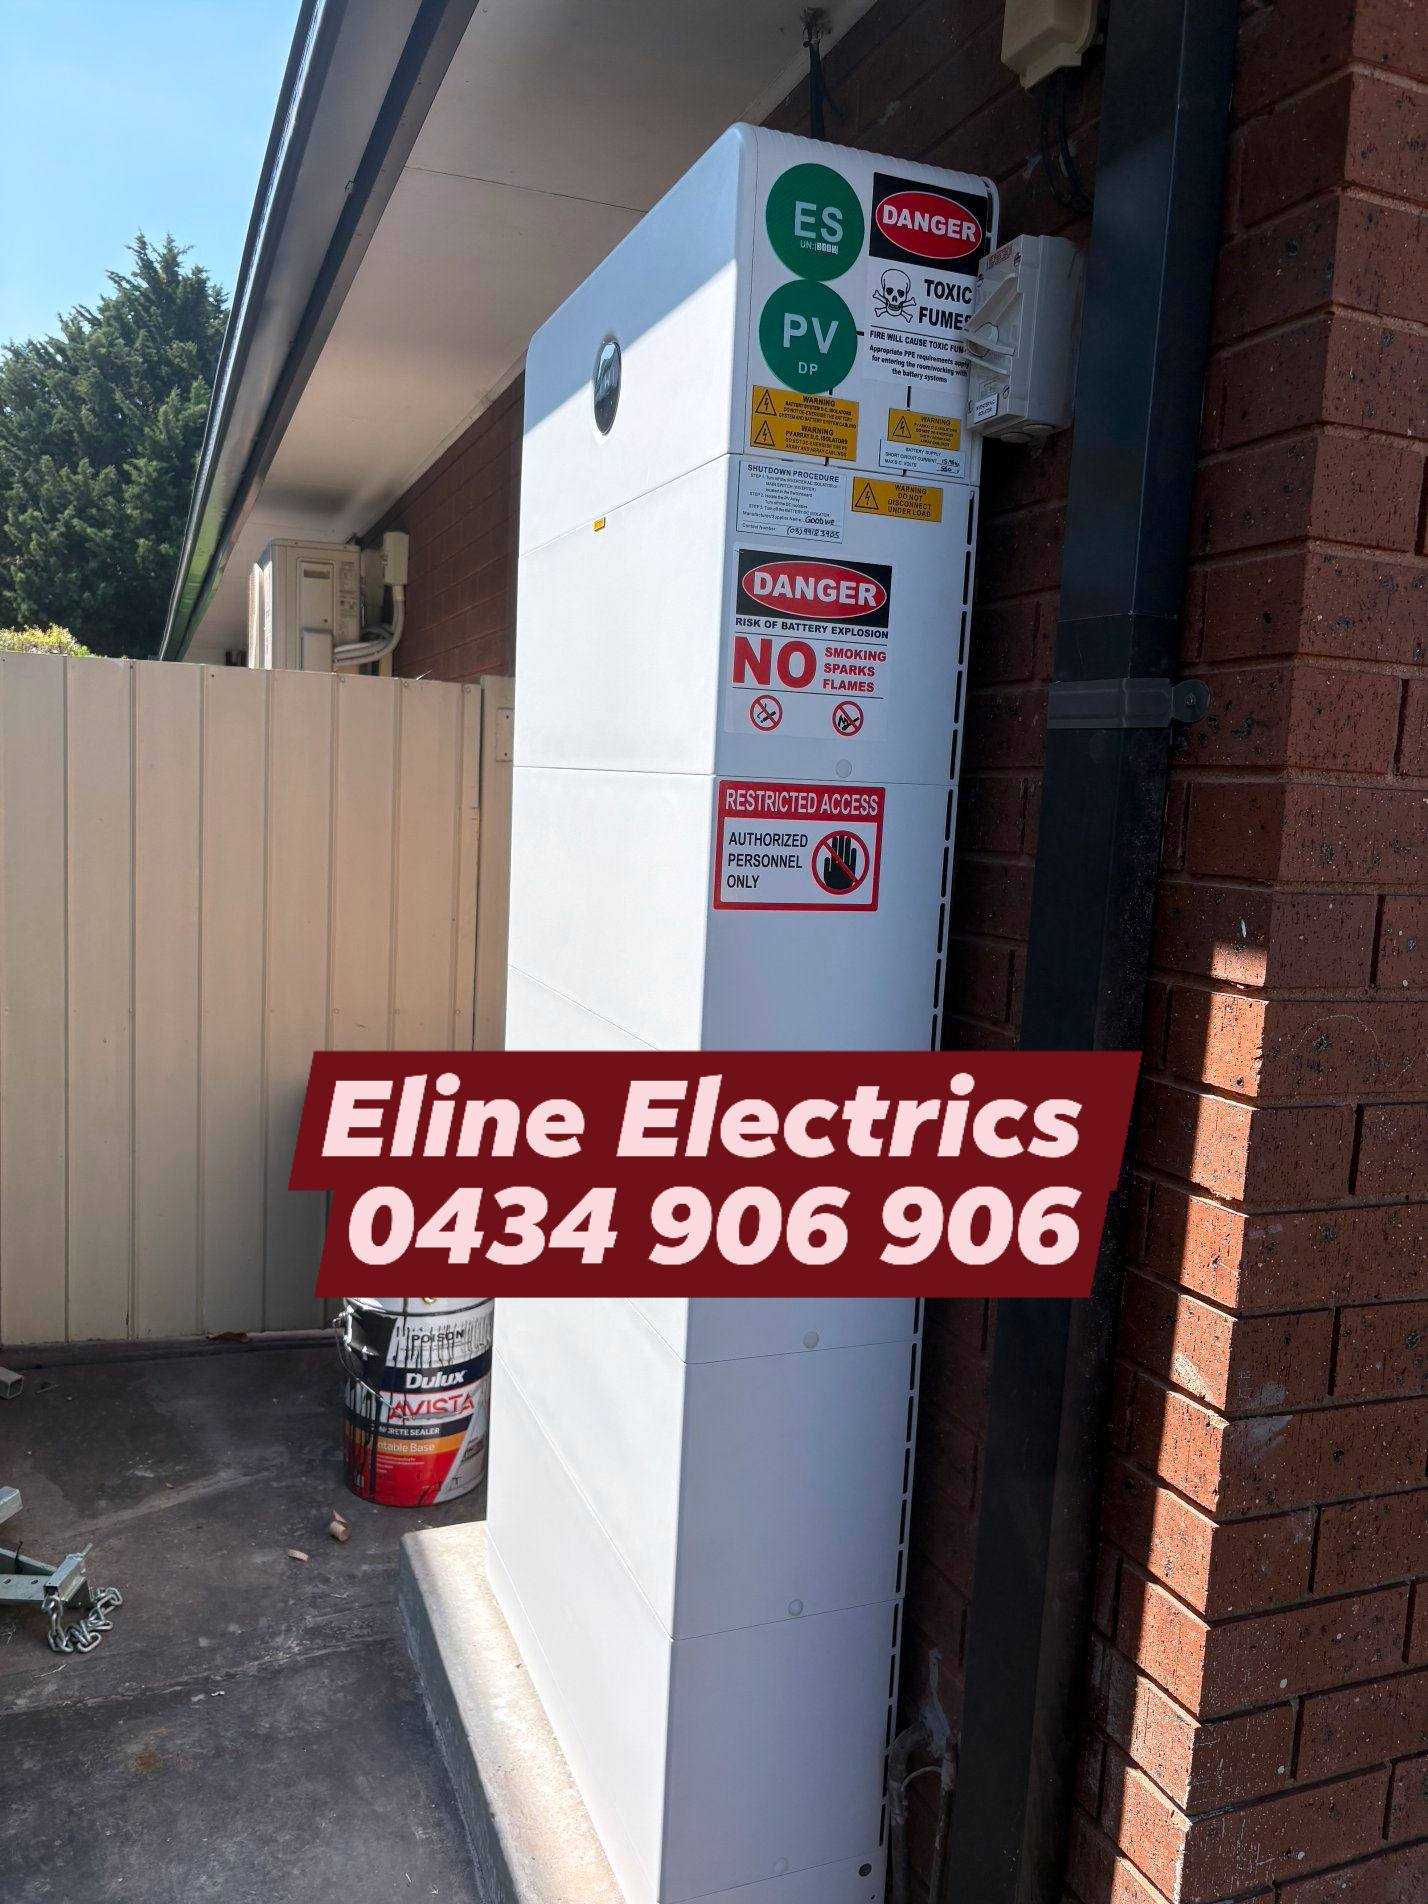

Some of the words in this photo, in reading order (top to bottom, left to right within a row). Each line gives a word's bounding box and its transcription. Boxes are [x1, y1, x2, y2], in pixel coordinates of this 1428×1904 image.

[794, 201, 844, 242] ES
[882, 204, 976, 242] DANGER
[924, 279, 972, 304] TOXIC
[783, 312, 839, 354] PV
[870, 330, 886, 340] FIRE
[887, 333, 903, 343] WILL
[905, 336, 927, 347] CAUSE
[929, 340, 948, 351] TOXIC
[870, 344, 903, 356] Appropriate
[904, 350, 915, 358] PPE
[917, 353, 953, 365] requirements
[954, 360, 970, 369] apply
[881, 357, 905, 367] entering
[955, 369, 968, 377] with
[903, 370, 923, 380] battery
[924, 374, 947, 383] systems
[803, 395, 835, 407] WARNING
[921, 416, 951, 426] WARNING
[801, 425, 834, 436] WARNING
[748, 464, 791, 476] SHUTDOWN
[793, 470, 840, 483] PROCEDURE
[894, 484, 927, 495] WARNING
[887, 499, 931, 510] DISCONNECT
[908, 494, 923, 502] NOT
[887, 506, 911, 515] UNDER
[912, 509, 931, 518] LOAD
[753, 571, 876, 607] DANGER
[736, 618, 761, 628] RISK
[764, 620, 778, 629] OF
[781, 621, 828, 634] BATTERY
[831, 627, 889, 639] EXPLOSION
[824, 646, 887, 662] SMOKING
[732, 636, 817, 689] NO
[824, 663, 875, 677] SPARKS
[823, 679, 875, 693] FLAMES
[725, 789, 818, 813] RESTRICTED
[819, 793, 879, 816] ACCESS
[728, 831, 809, 848] AUTHORIZED
[728, 853, 803, 869] PERSONNEL
[726, 874, 760, 889] ONLY
[412, 1329, 465, 1344] POISON
[406, 1370, 466, 1389] Dulux
[389, 1393, 475, 1420] AVISTA
[410, 1427, 440, 1436] SEALER
[410, 1442, 435, 1453] Base
